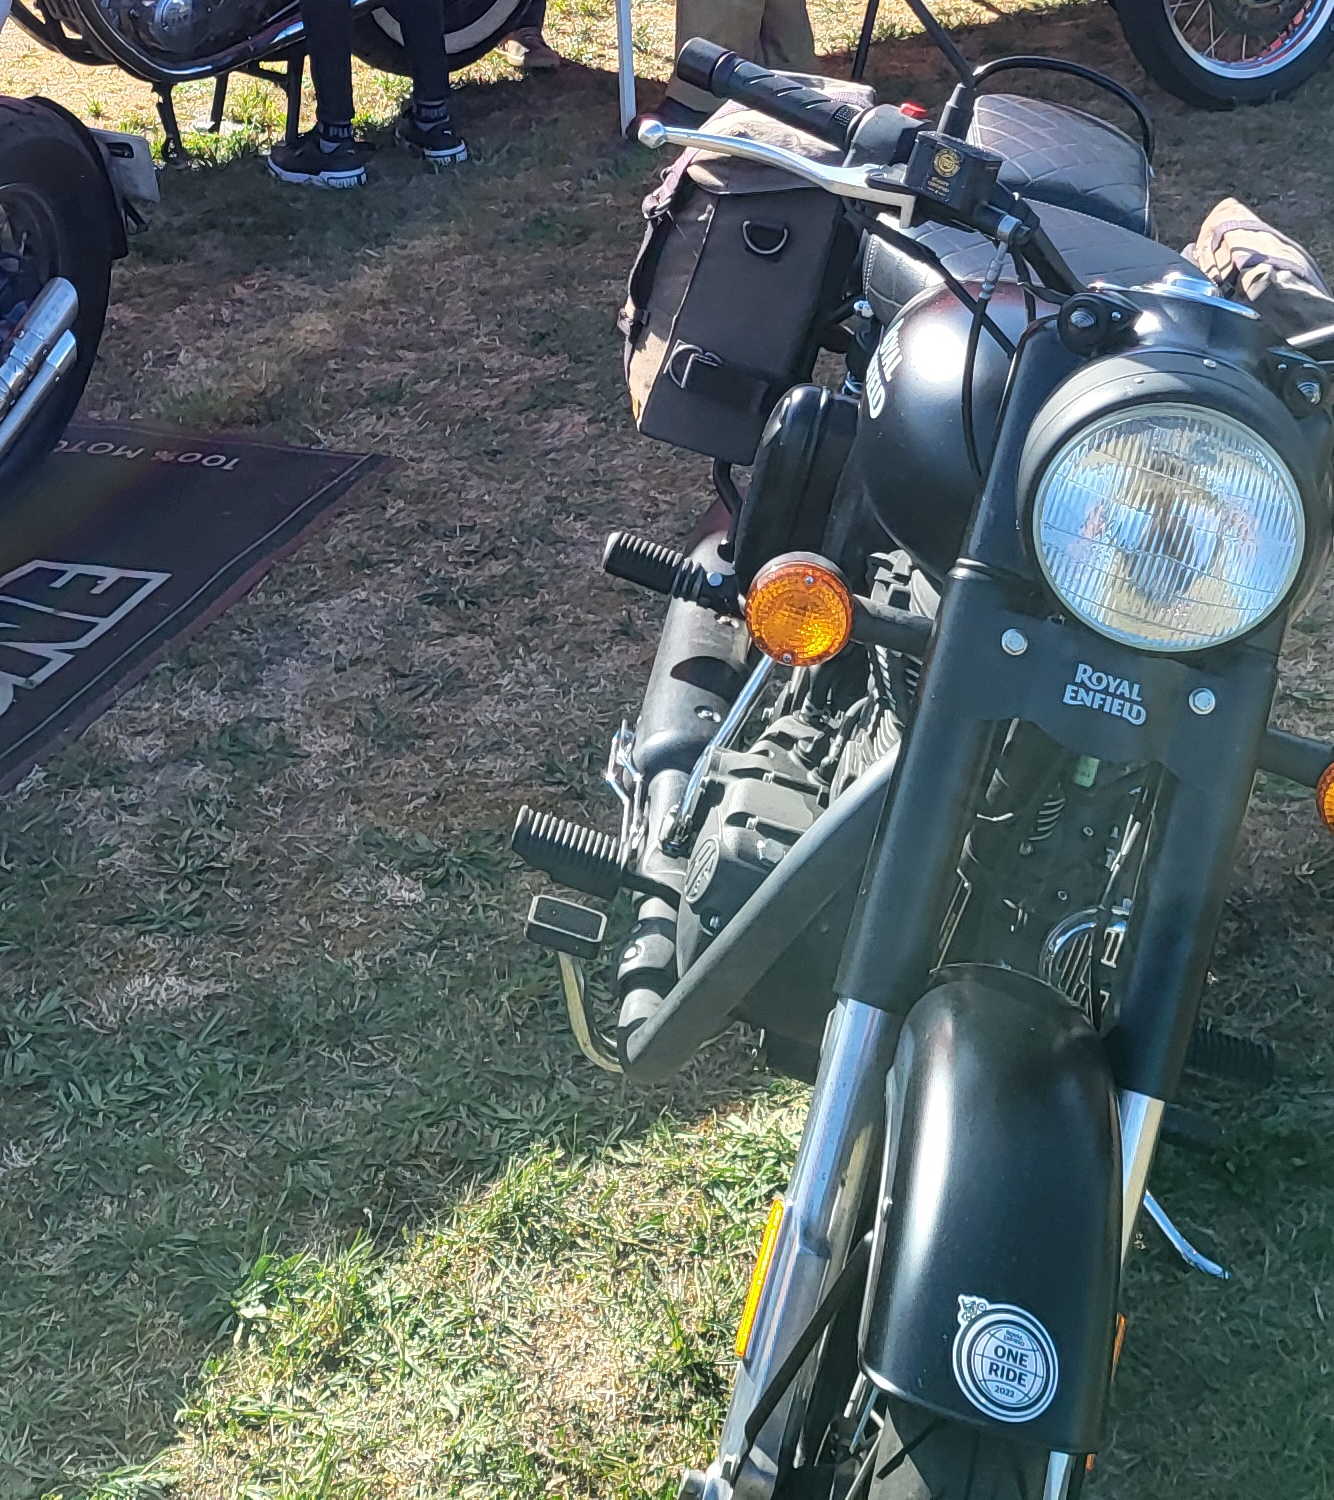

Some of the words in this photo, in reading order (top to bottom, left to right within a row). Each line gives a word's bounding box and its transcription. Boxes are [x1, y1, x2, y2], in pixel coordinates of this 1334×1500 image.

[150, 451, 241, 471] 100%
[1074, 663, 1143, 702] ROYAL
[1062, 684, 1147, 726] ENFIELD
[993, 1345, 1030, 1369] ONE
[988, 1362, 1029, 1388] RIDE
[993, 1385, 1015, 1399] 2022
